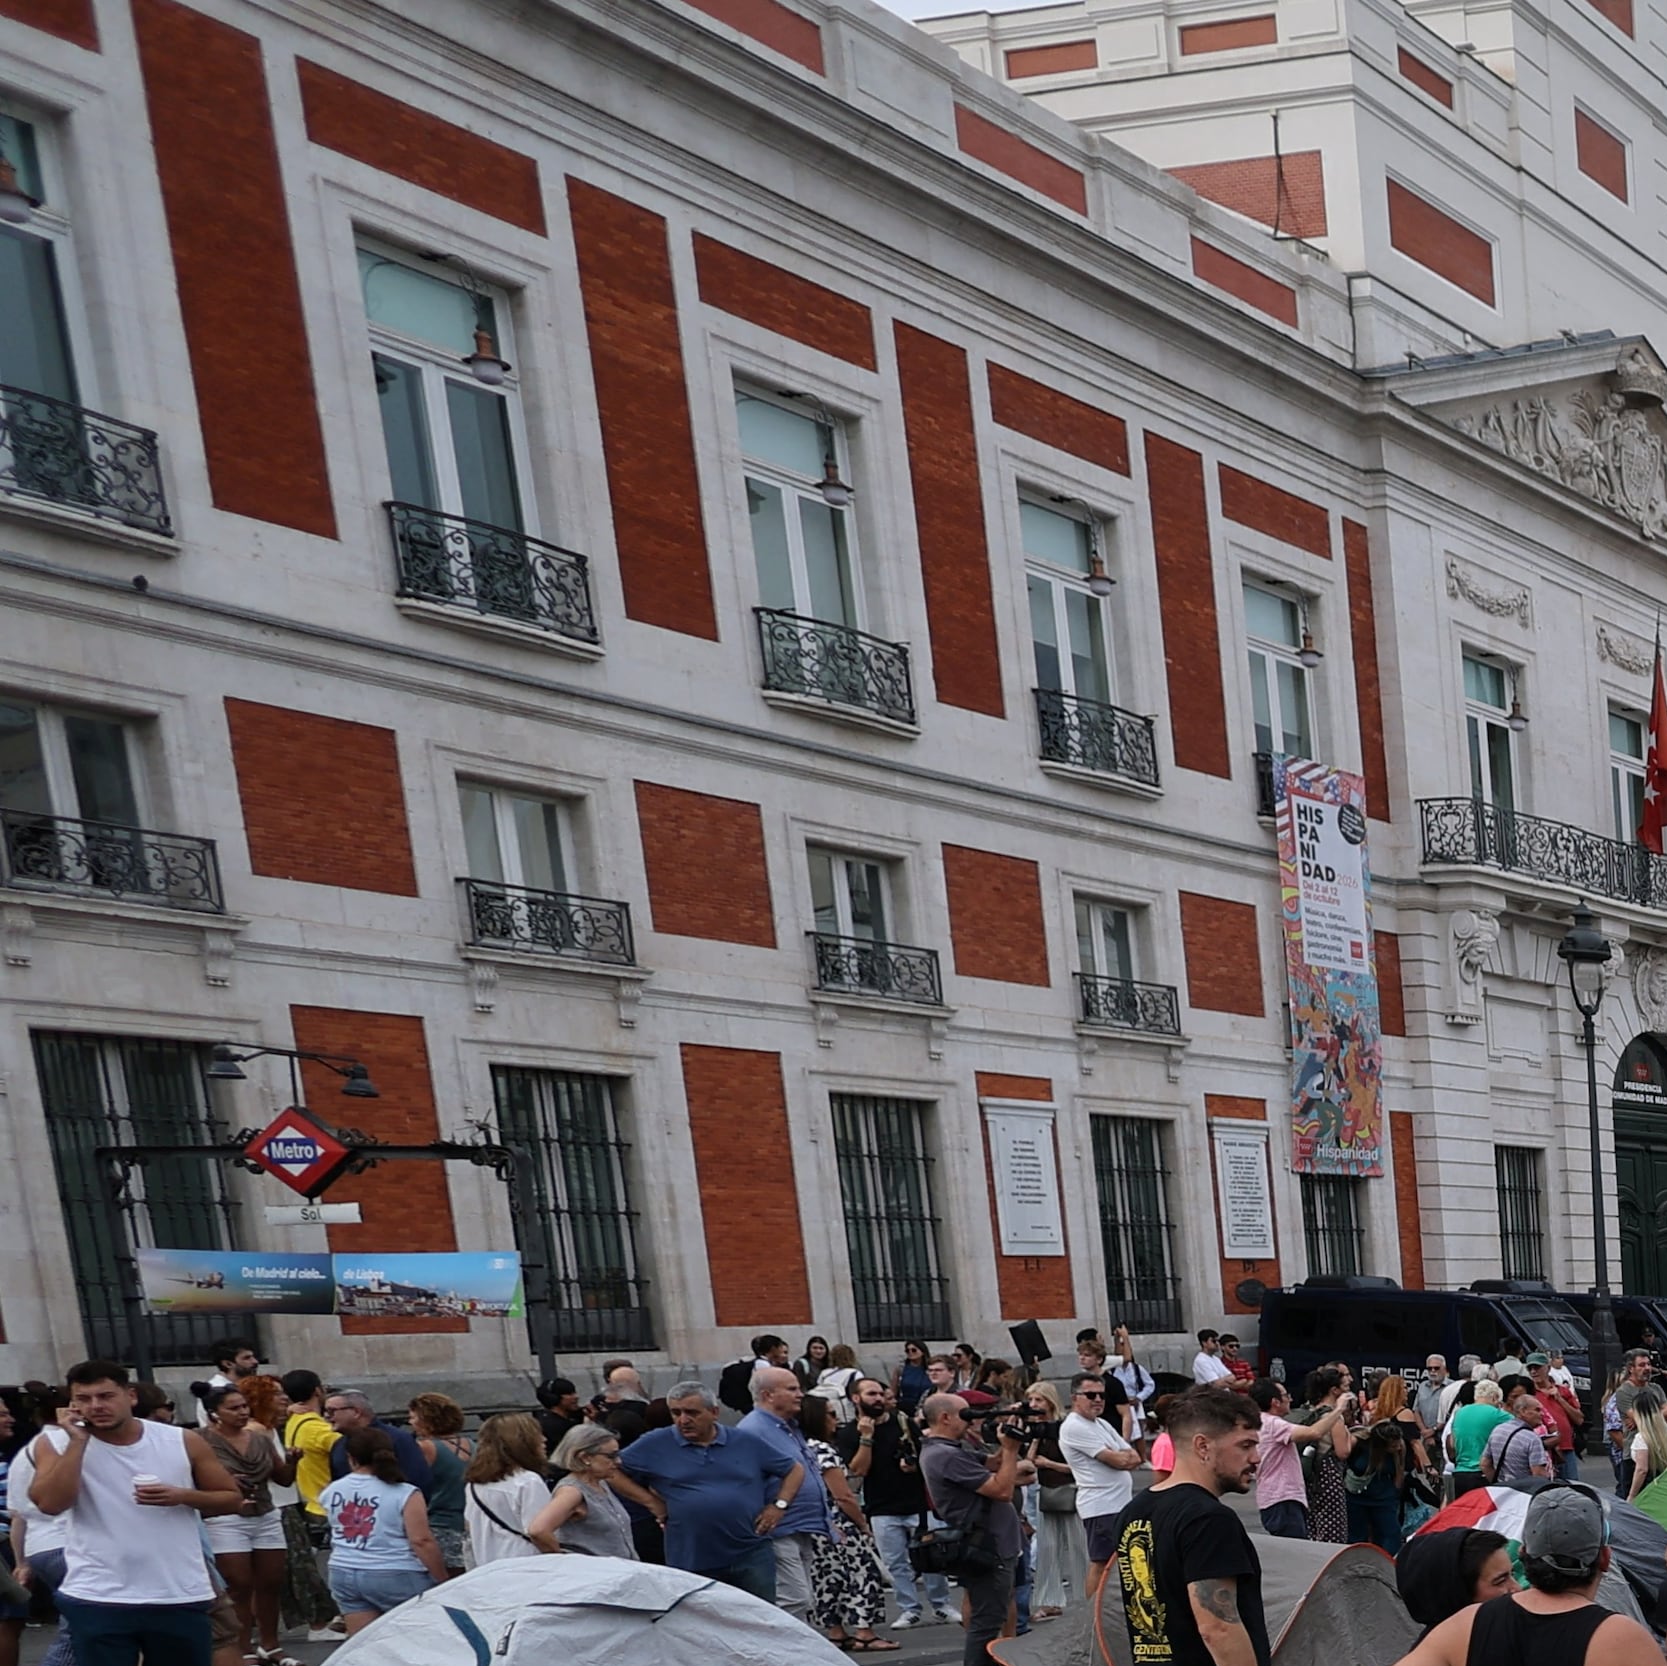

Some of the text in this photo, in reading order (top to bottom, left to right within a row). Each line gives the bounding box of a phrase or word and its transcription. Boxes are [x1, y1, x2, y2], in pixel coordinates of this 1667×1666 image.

[1297, 803, 1324, 825] HIS
[1299, 824, 1320, 843] PA
[1301, 842, 1316, 861] NI
[1302, 860, 1336, 882] DAD
[270, 1141, 314, 1160] Metro
[1317, 1143, 1379, 1161] Hispanidad
[300, 1207, 322, 1221] Sol
[241, 1267, 254, 1279] De
[255, 1267, 288, 1280] Madrid
[289, 1267, 297, 1280] al
[1119, 1556, 1134, 1592] SANTA
